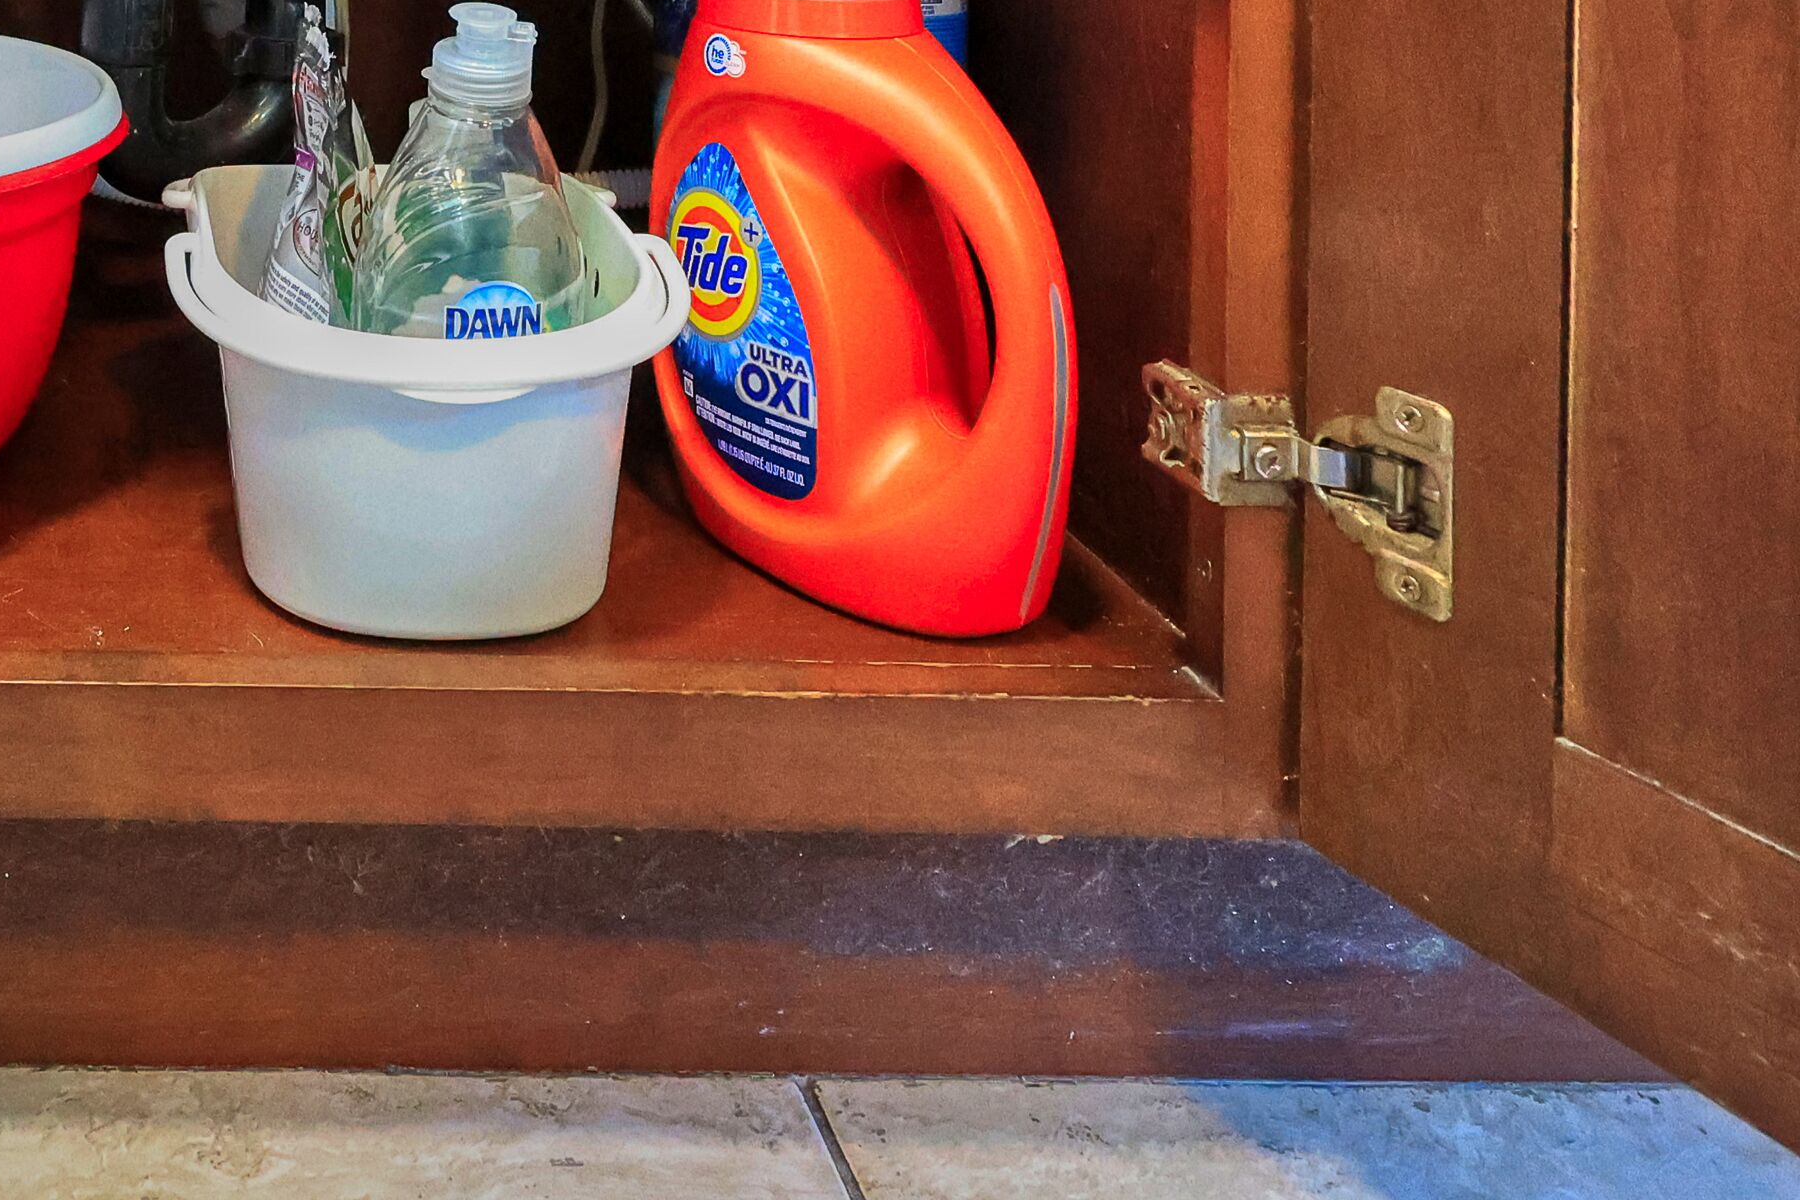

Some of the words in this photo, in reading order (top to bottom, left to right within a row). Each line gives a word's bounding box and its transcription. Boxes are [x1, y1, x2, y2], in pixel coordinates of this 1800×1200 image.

[676, 224, 747, 299] Tide
[444, 303, 542, 340] DAWN
[748, 344, 807, 376] ULTRA
[741, 359, 809, 421] OXI
